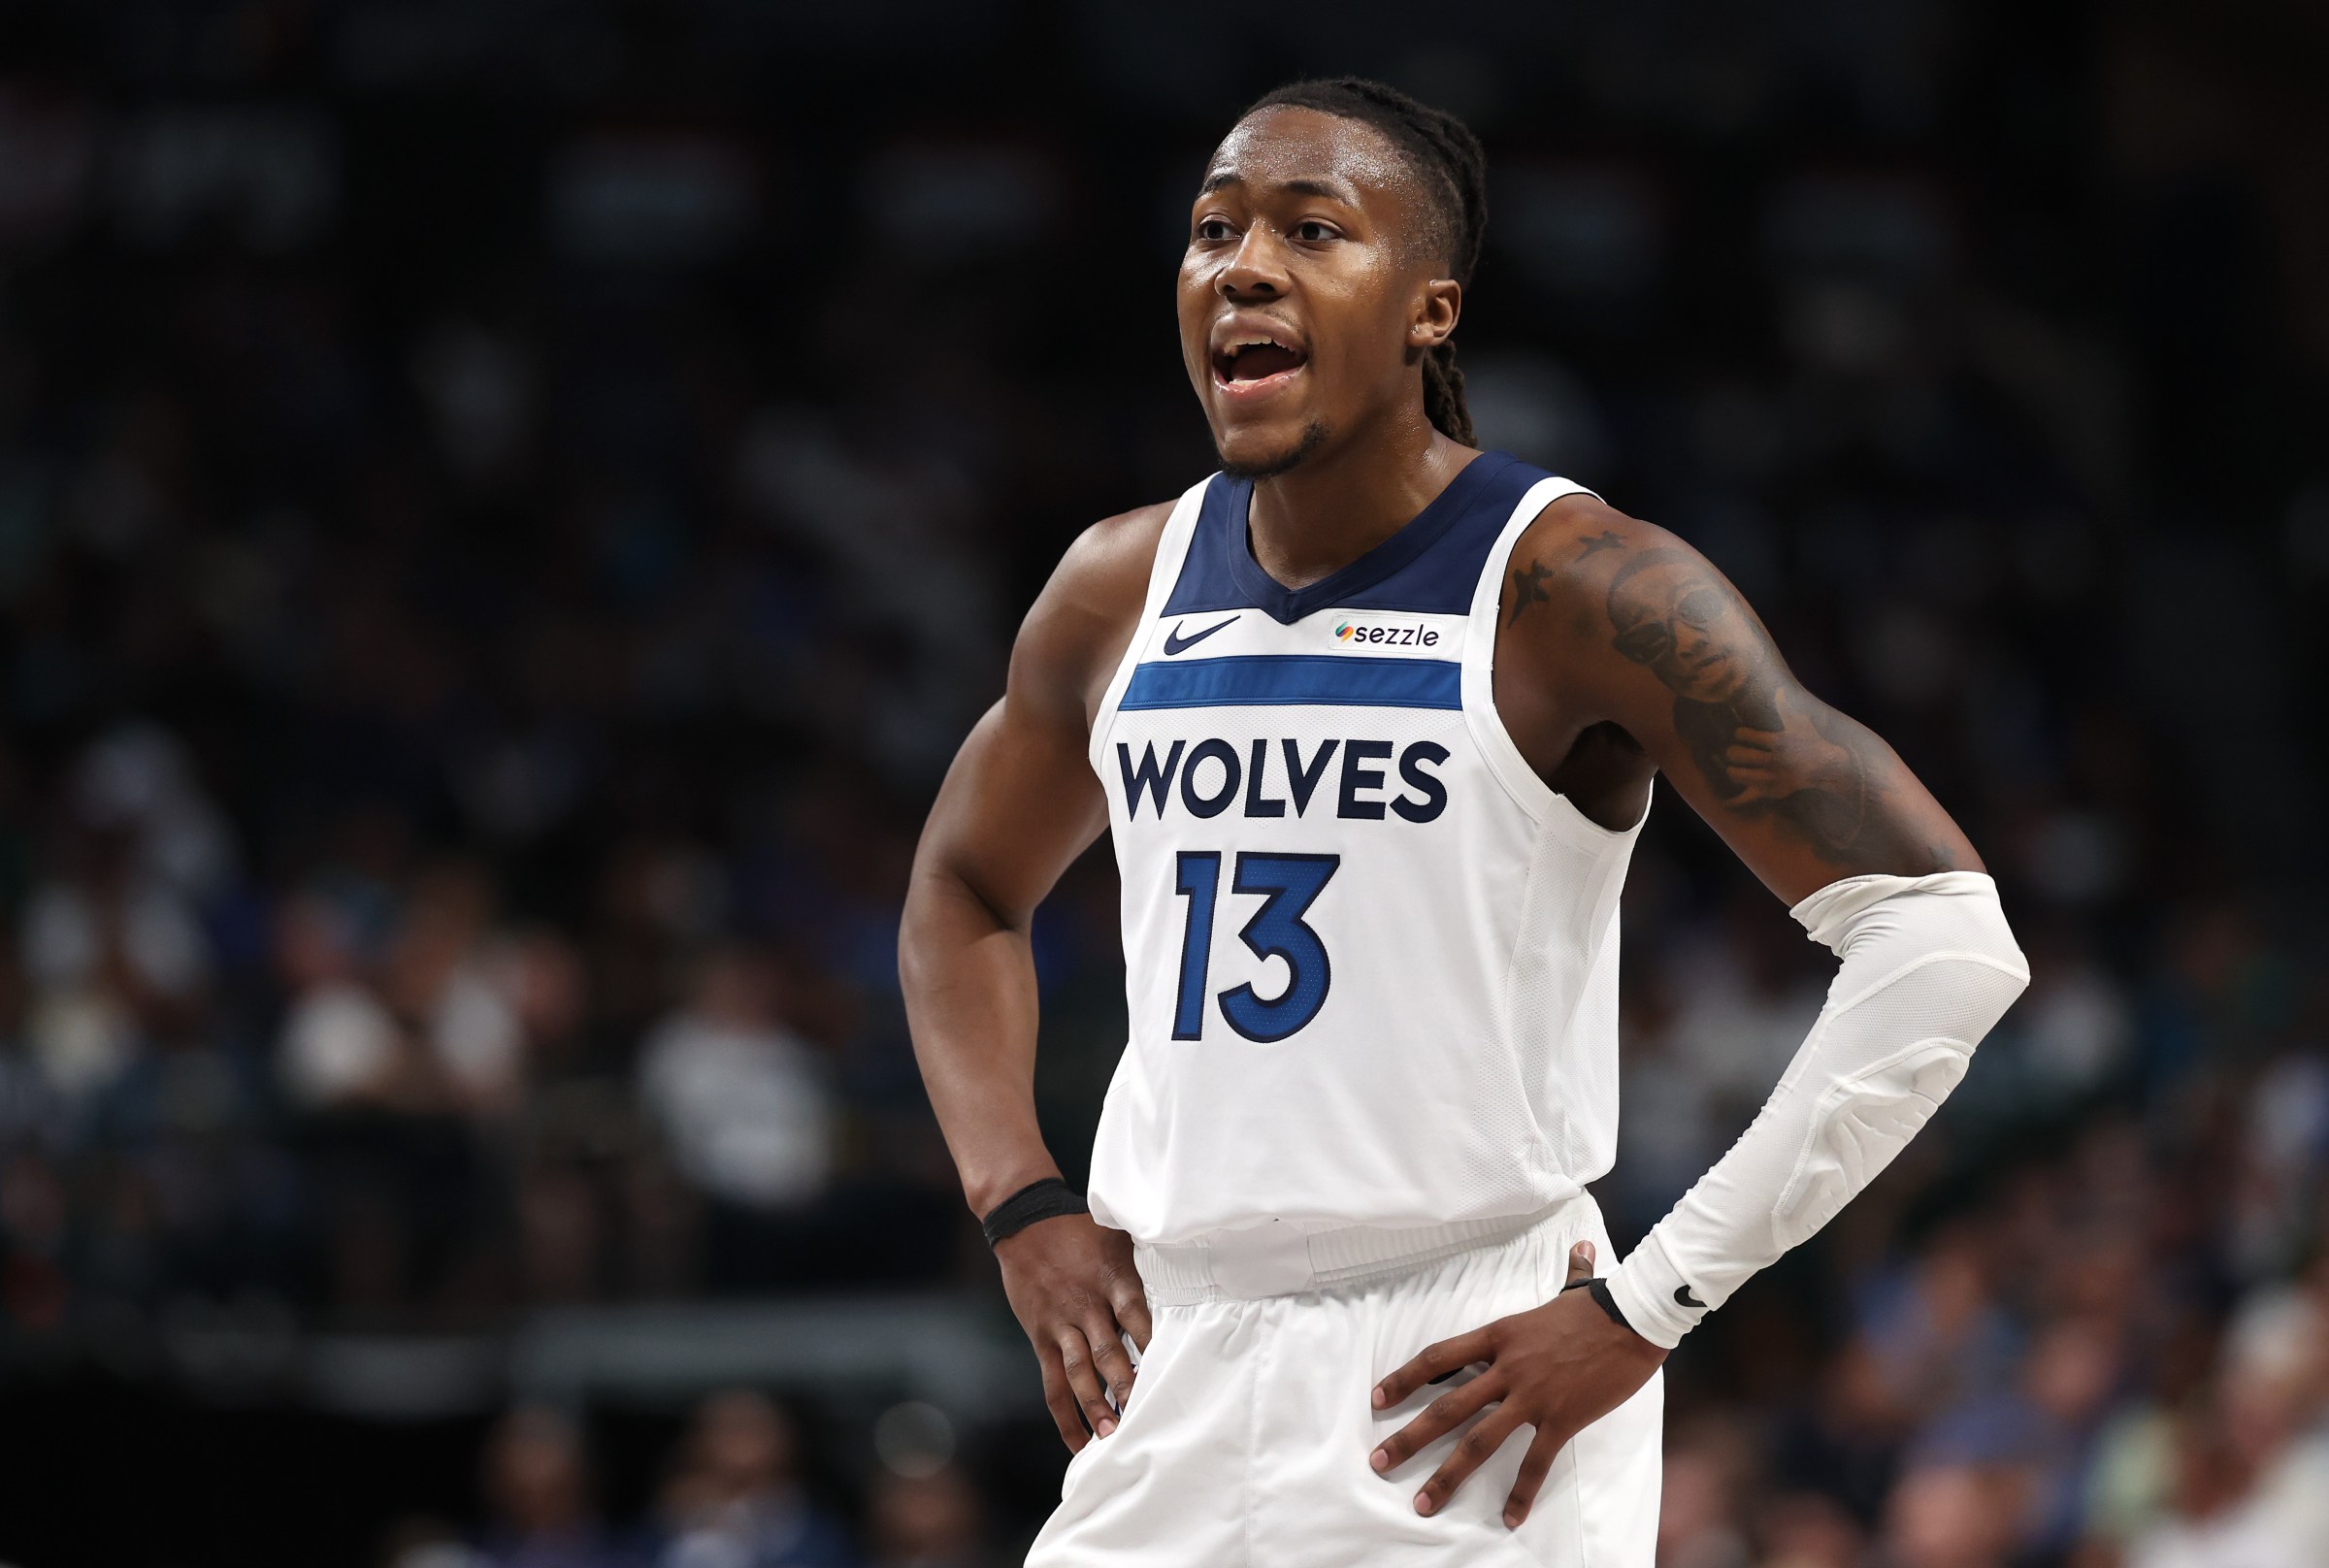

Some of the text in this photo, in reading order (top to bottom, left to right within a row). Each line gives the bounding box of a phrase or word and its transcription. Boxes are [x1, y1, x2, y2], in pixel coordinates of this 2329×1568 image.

[1354, 623, 1439, 647] sezzle
[1116, 737, 1451, 824] WOLVES
[1170, 850, 1341, 1044] 13
